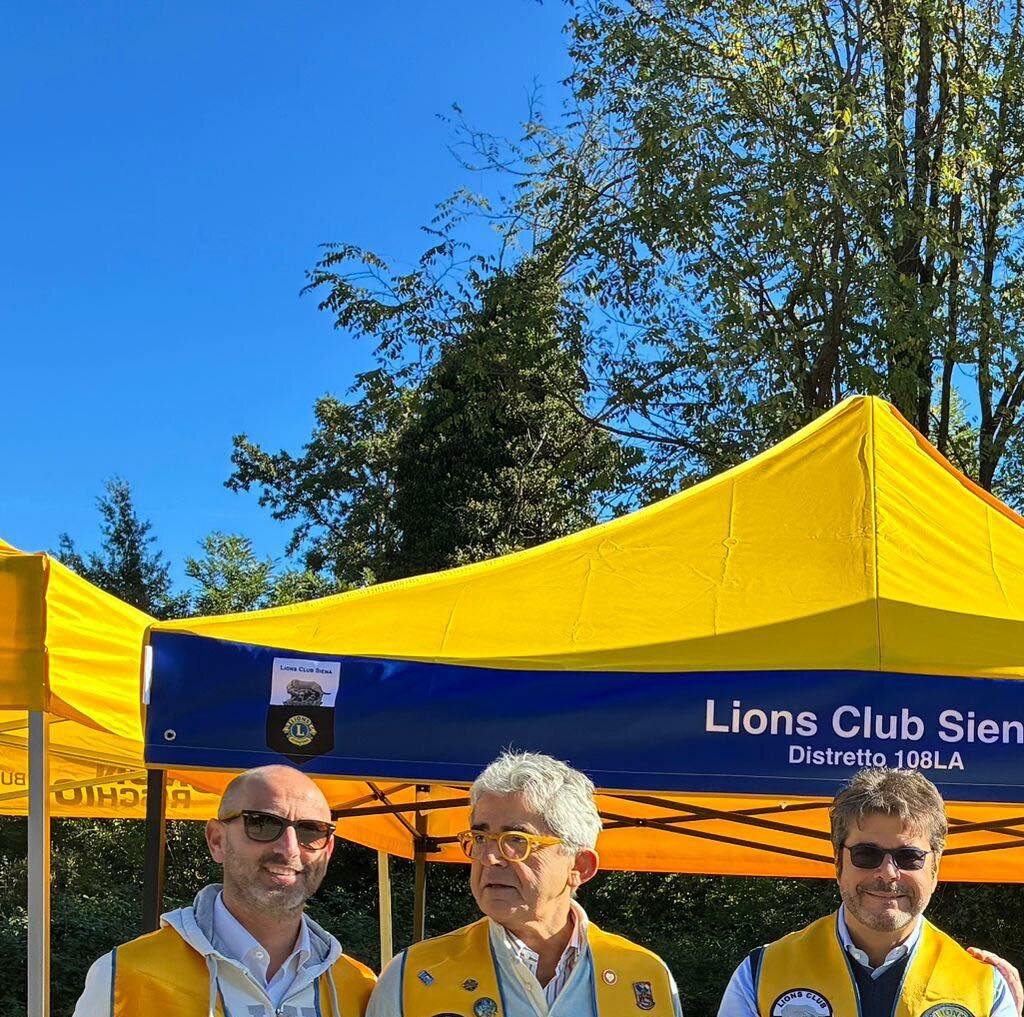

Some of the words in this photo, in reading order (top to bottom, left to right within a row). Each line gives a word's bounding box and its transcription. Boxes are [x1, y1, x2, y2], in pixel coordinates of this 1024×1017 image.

[296, 724, 304, 736] L
[705, 699, 818, 737] Lions
[832, 705, 925, 741] Club
[788, 745, 887, 768] Distretto
[894, 750, 964, 770] 108LA
[777, 991, 803, 1008] LIONS
[806, 992, 827, 1009] CLUB
